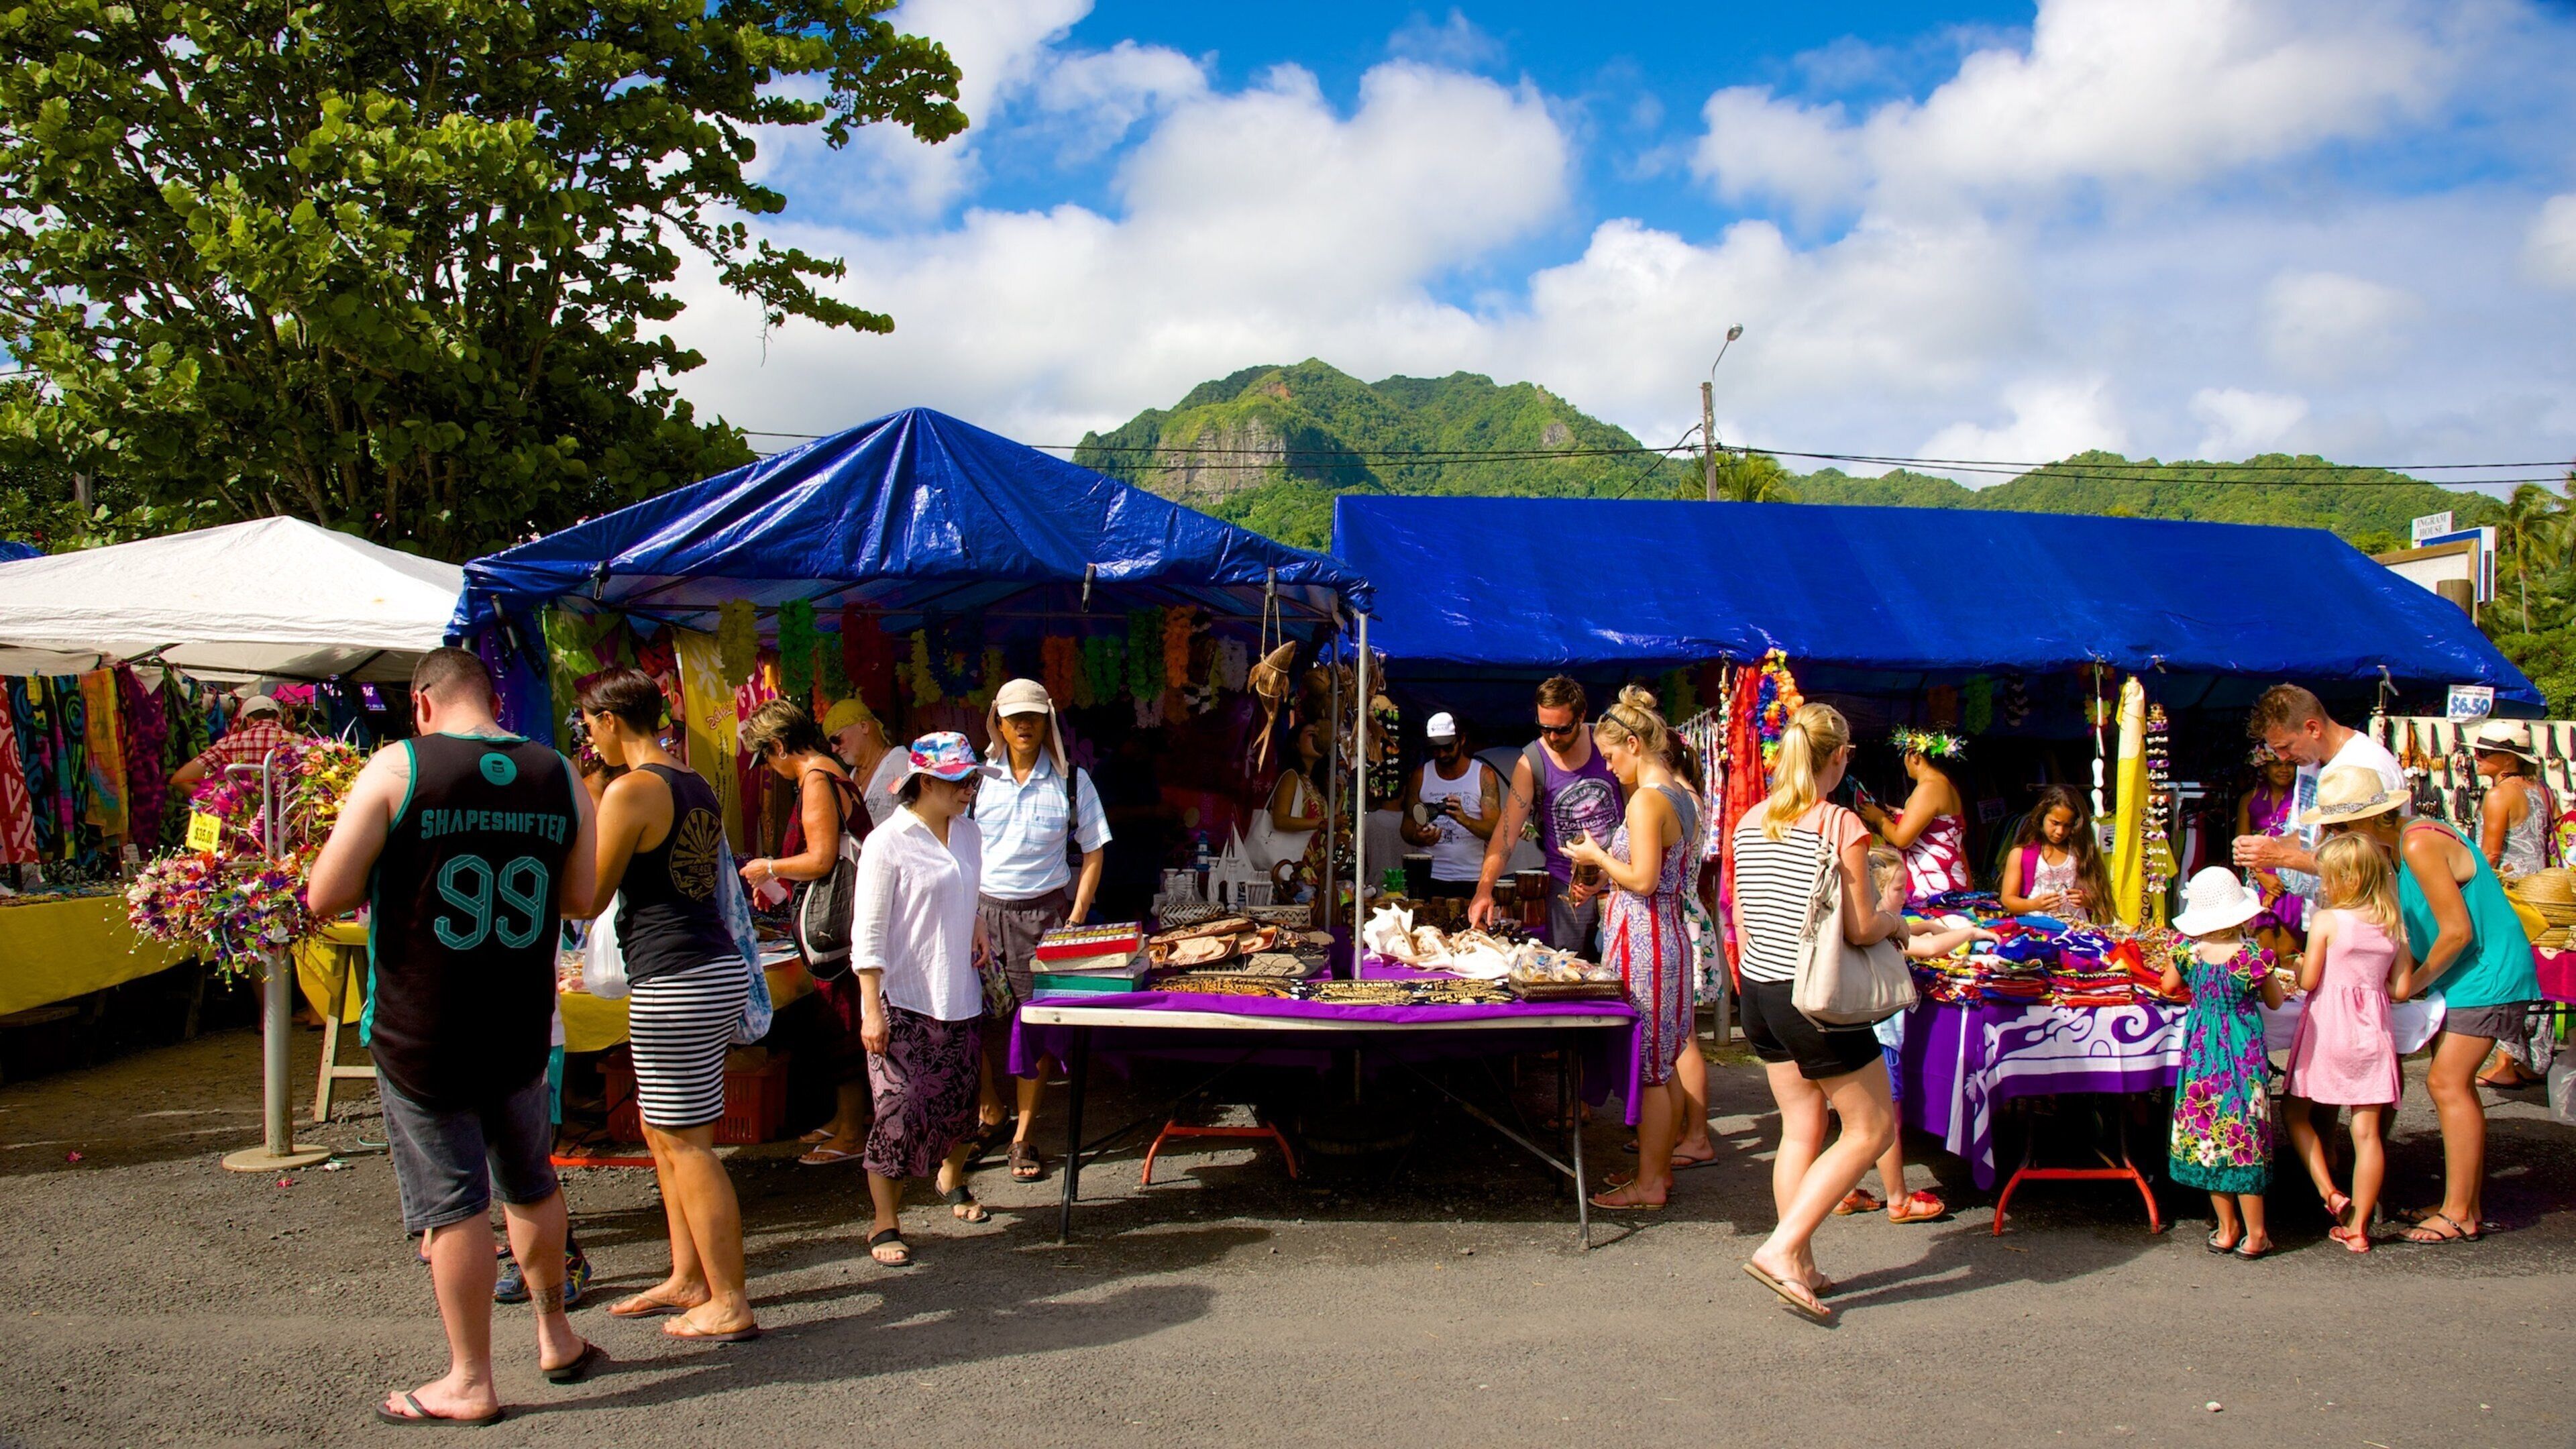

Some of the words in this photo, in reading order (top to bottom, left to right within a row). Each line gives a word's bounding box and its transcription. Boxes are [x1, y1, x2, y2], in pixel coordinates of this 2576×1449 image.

[2417, 513, 2447, 528] INGRAM
[2420, 525, 2443, 537] HOUSE
[2451, 695, 2489, 716] $6.50
[421, 809, 566, 845] SHAPESHIFTER
[434, 854, 549, 950] 99
[1047, 926, 1085, 934] ONE
[1095, 922, 1137, 930] LIFE
[1075, 927, 1136, 938] CHANCE
[1040, 938, 1063, 947] NO
[1063, 933, 1134, 946] REGRETS
